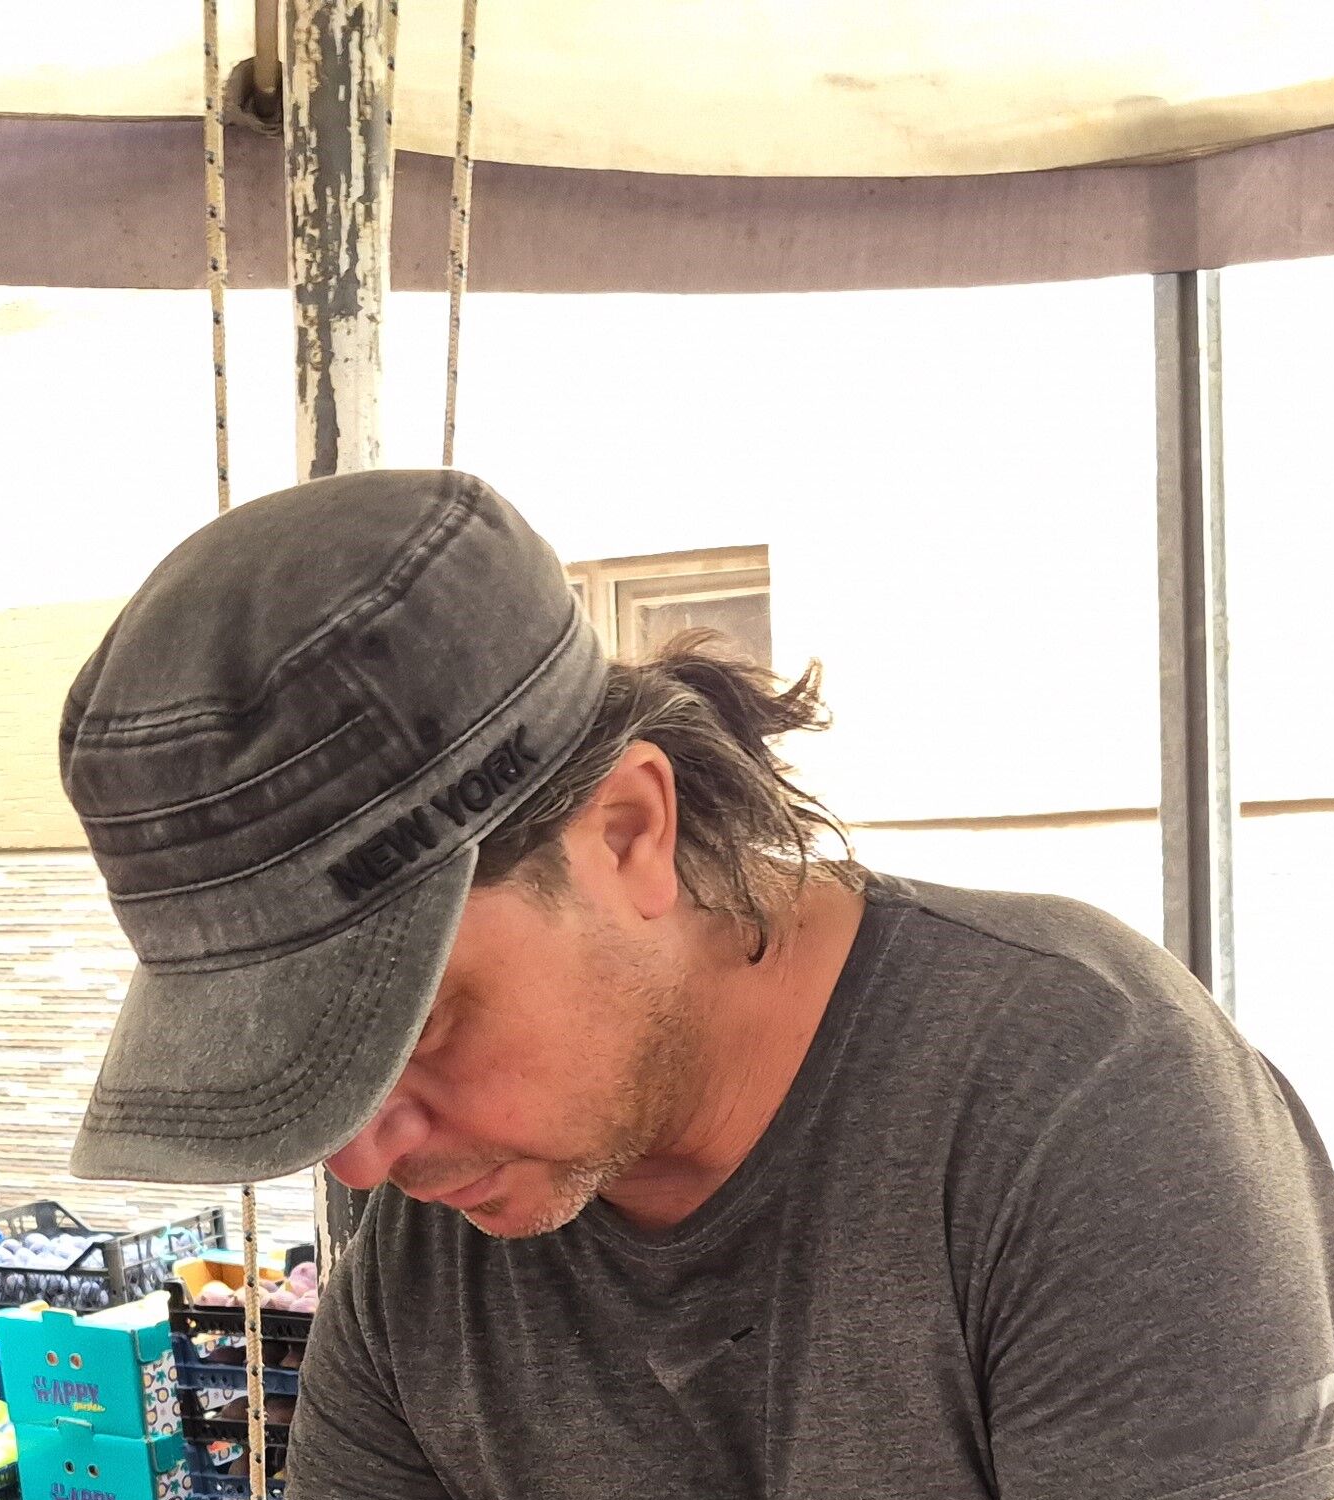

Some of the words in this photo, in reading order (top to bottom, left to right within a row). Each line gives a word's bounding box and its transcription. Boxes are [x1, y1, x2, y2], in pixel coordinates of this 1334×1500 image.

[327, 804, 440, 900] NEW
[430, 724, 540, 827] YORK
[34, 1375, 99, 1406] HAPPY
